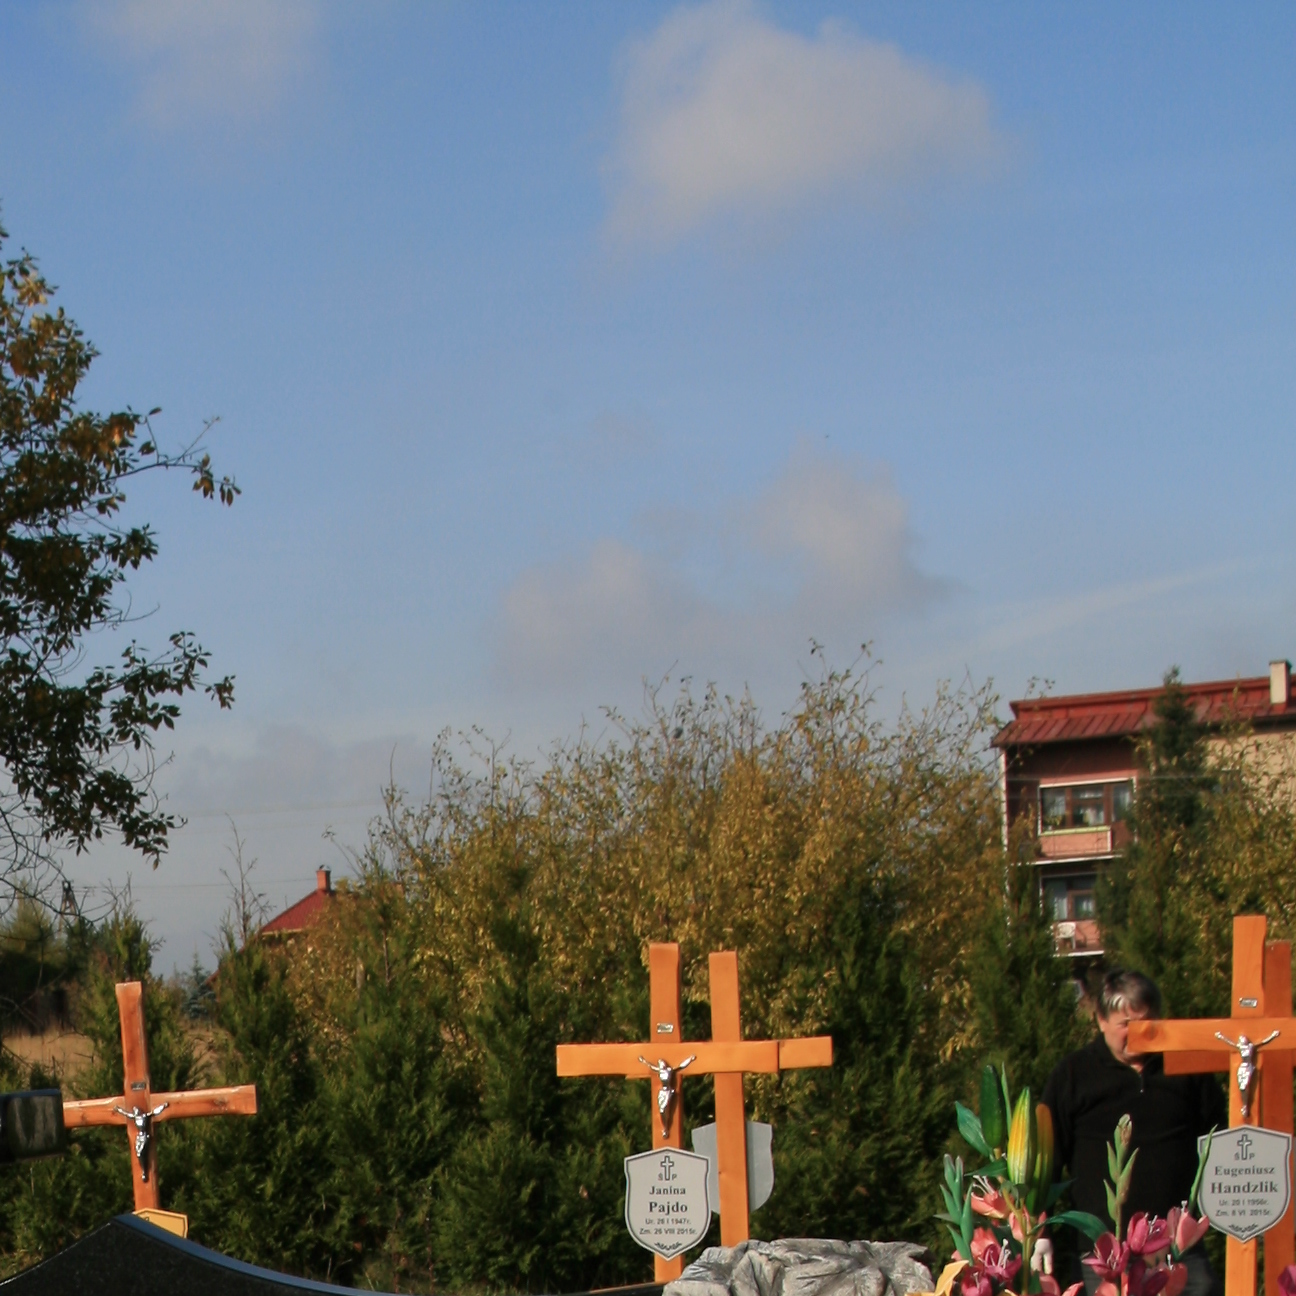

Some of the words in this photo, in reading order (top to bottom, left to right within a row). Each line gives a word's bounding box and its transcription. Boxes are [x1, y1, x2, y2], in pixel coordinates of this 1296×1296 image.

[1214, 1165, 1275, 1177] Eugeniusz
[649, 1185, 686, 1195] Janina
[1211, 1181, 1278, 1194] Handzlik
[649, 1201, 688, 1216] Pajdo
